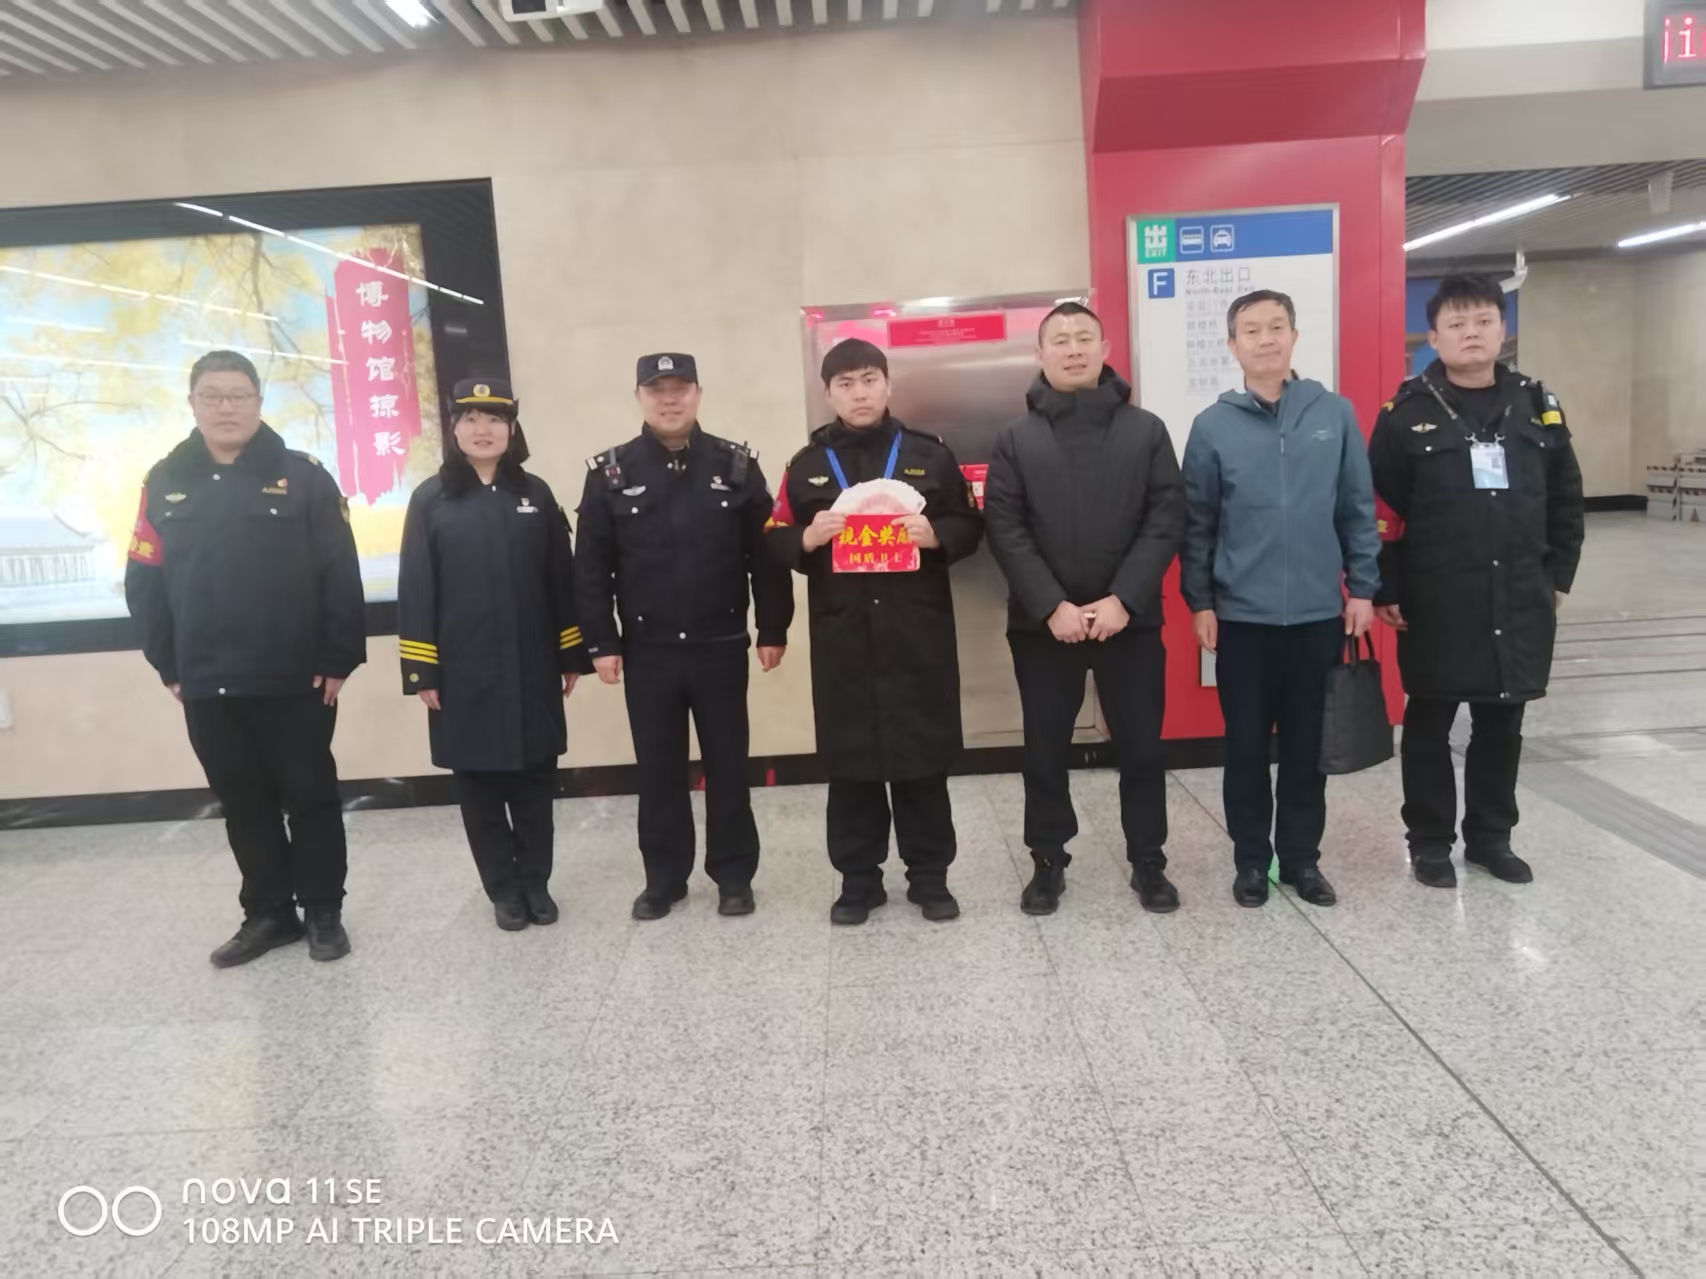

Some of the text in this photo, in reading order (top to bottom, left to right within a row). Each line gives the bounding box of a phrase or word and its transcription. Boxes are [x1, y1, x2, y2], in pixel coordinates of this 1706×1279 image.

[1144, 224, 1168, 248] 出
[1153, 272, 1169, 295] F
[1185, 265, 1250, 285] 东北出口
[355, 280, 405, 457] 博物馆掠影
